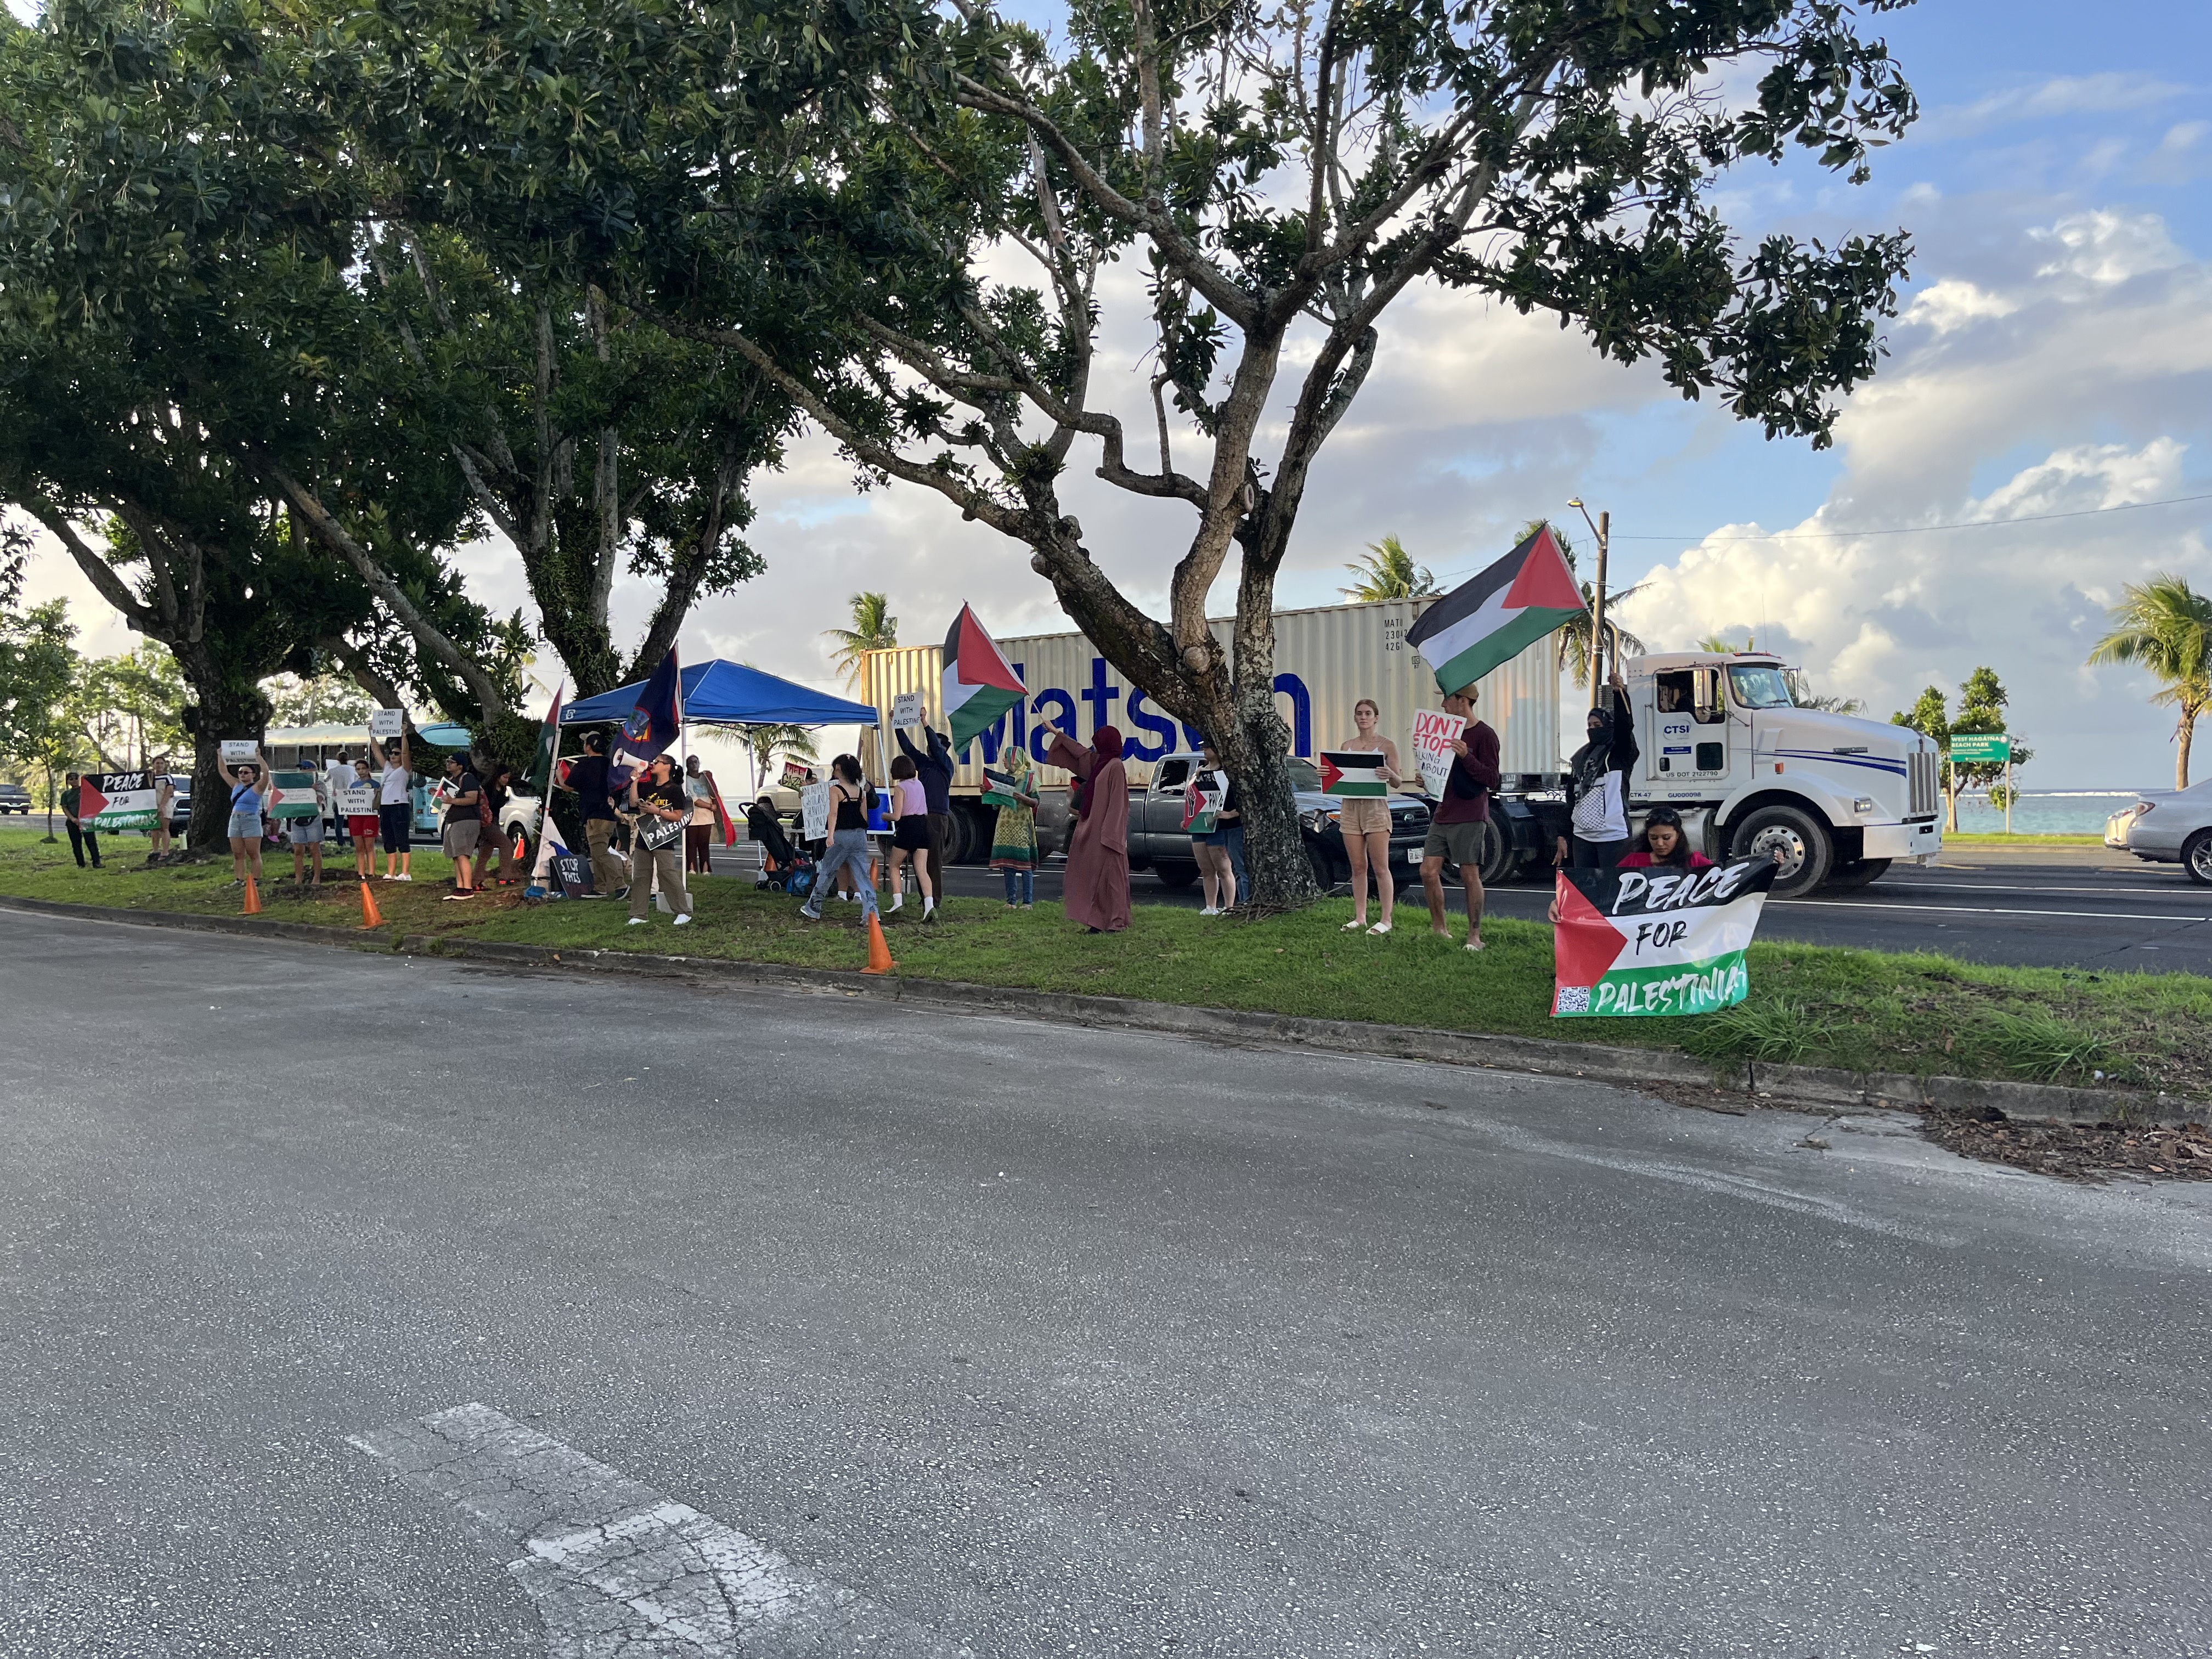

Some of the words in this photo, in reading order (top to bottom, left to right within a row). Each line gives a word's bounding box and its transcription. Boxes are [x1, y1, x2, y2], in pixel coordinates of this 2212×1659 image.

[1384, 619, 1403, 628] MATU
[1385, 629, 1408, 639] 23042
[958, 658, 1311, 764] Matsn
[894, 717, 920, 726] PALESTINE
[1415, 713, 1463, 738] DON'T
[1664, 725, 1690, 733] CTSI
[1413, 733, 1452, 757] STOP
[785, 763, 804, 775] FREE
[1421, 761, 1449, 777] ABOUT
[102, 772, 145, 792] PEACE
[782, 772, 802, 788] GAZA
[112, 796, 131, 808] FOR
[560, 858, 578, 871] STOP
[562, 871, 581, 883] THIS
[1612, 862, 1749, 915] PEACE
[1636, 921, 1688, 956] FOR
[1595, 967, 1747, 1013] PALESTINIA
